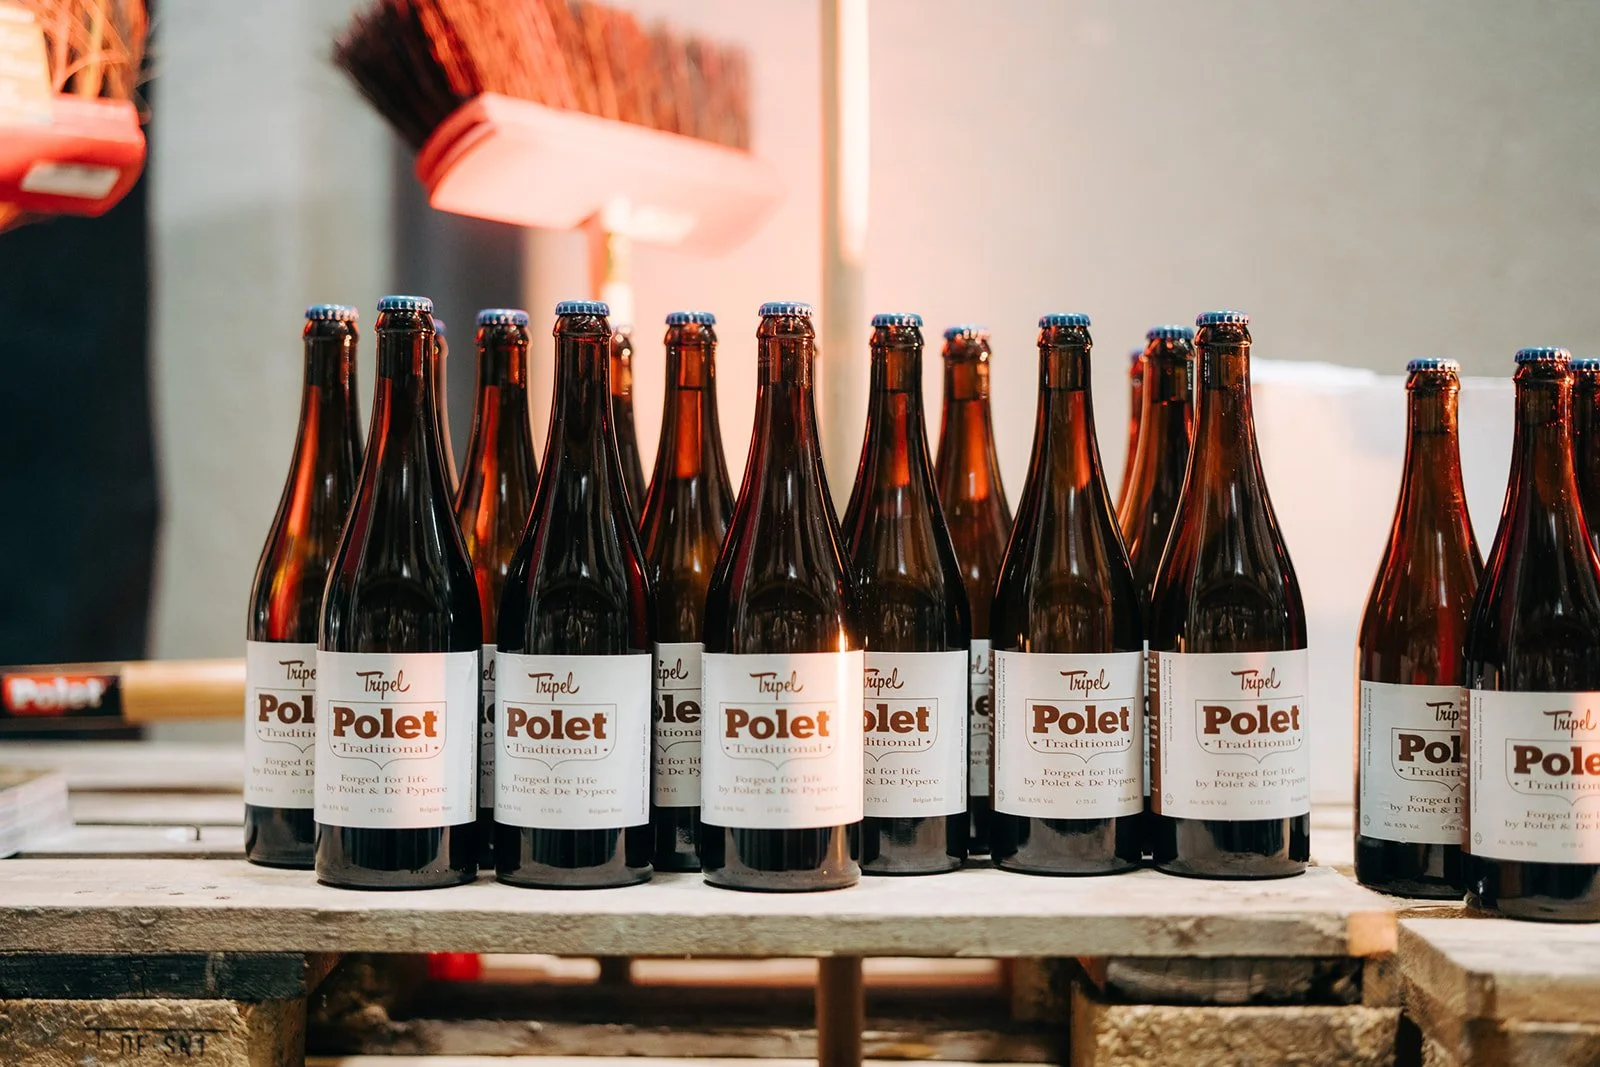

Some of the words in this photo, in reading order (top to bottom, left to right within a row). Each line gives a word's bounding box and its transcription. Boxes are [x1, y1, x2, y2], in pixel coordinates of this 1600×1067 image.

[279, 660, 316, 687] Tripe
[657, 658, 689, 687] ipel
[356, 670, 411, 700] Tripel
[528, 671, 580, 701] Tripel
[750, 671, 804, 700] Tripel
[1060, 668, 1111, 698] Tripel
[1230, 667, 1281, 697] Tripel
[258, 693, 314, 724] Pol
[1426, 701, 1459, 728] Trip
[333, 706, 438, 739] Polet
[506, 707, 607, 741] Polet
[725, 708, 830, 739] Polet
[864, 703, 929, 733] olet
[1032, 704, 1130, 735] Polet
[1203, 704, 1300, 735] Polet
[1543, 709, 1597, 738] Tripel
[265, 728, 315, 738] Traditi
[658, 728, 701, 738] itiona
[340, 742, 429, 754] Traditional
[513, 742, 599, 755] Traditional
[733, 743, 823, 754] Traditional
[1042, 737, 1125, 749] Traditional
[1213, 737, 1296, 749] Traditional
[1398, 733, 1460, 764] Pol
[265, 757, 301, 768] Forged
[305, 758, 315, 766] fo
[667, 758, 685, 766] for
[689, 757, 701, 766] lif
[1513, 745, 1600, 776] Pole
[263, 767, 287, 776] Polet
[305, 769, 315, 777] D
[668, 768, 684, 776] De
[880, 767, 899, 775] for
[901, 767, 921, 775] life
[1043, 768, 1085, 779] Forged
[1089, 768, 1106, 777] for
[1108, 767, 1124, 776] life
[1216, 769, 1258, 779] Forged
[1262, 768, 1279, 777] for
[1281, 767, 1296, 775] life
[1408, 767, 1460, 777] Traditi
[340, 774, 380, 785] Forged
[384, 774, 404, 783] for
[407, 774, 428, 783] life
[513, 774, 550, 786] Forged
[554, 776, 574, 785] for
[576, 775, 598, 785] life
[735, 775, 776, 786] Forged
[780, 775, 800, 783] for
[802, 775, 823, 783] life
[879, 778, 896, 786] De
[899, 778, 940, 788] Pypere
[1024, 778, 1037, 788] by
[1041, 778, 1070, 787] Polet
[1074, 779, 1085, 787] &
[1089, 778, 1106, 787] De
[1107, 776, 1137, 787] Pypere
[1195, 780, 1209, 790] by
[1214, 780, 1244, 788] Polet
[1248, 780, 1259, 788] &
[1262, 779, 1278, 787] De
[1280, 777, 1306, 788] Pypere
[1524, 778, 1600, 791] Tradition
[326, 784, 336, 794] by
[338, 785, 365, 794] Polet
[369, 786, 379, 794] &
[384, 786, 402, 795] De
[406, 786, 448, 796] Pypere
[501, 784, 510, 793] by
[511, 785, 536, 795] Polet
[539, 787, 550, 795] &
[554, 787, 572, 796] De
[575, 787, 617, 797] Pypere
[718, 785, 729, 796] by
[733, 785, 761, 795] Polet
[765, 787, 775, 795] &
[780, 786, 800, 795] De
[1409, 795, 1446, 805] Forged
[1390, 803, 1402, 814] by
[1407, 804, 1435, 814] Polet
[1440, 806, 1451, 814] &
[1526, 810, 1571, 822] Forged
[1575, 810, 1592, 819] for
[1504, 819, 1518, 831] by
[1523, 820, 1556, 830] Polet
[1560, 822, 1571, 830] &
[1575, 821, 1592, 830] De
